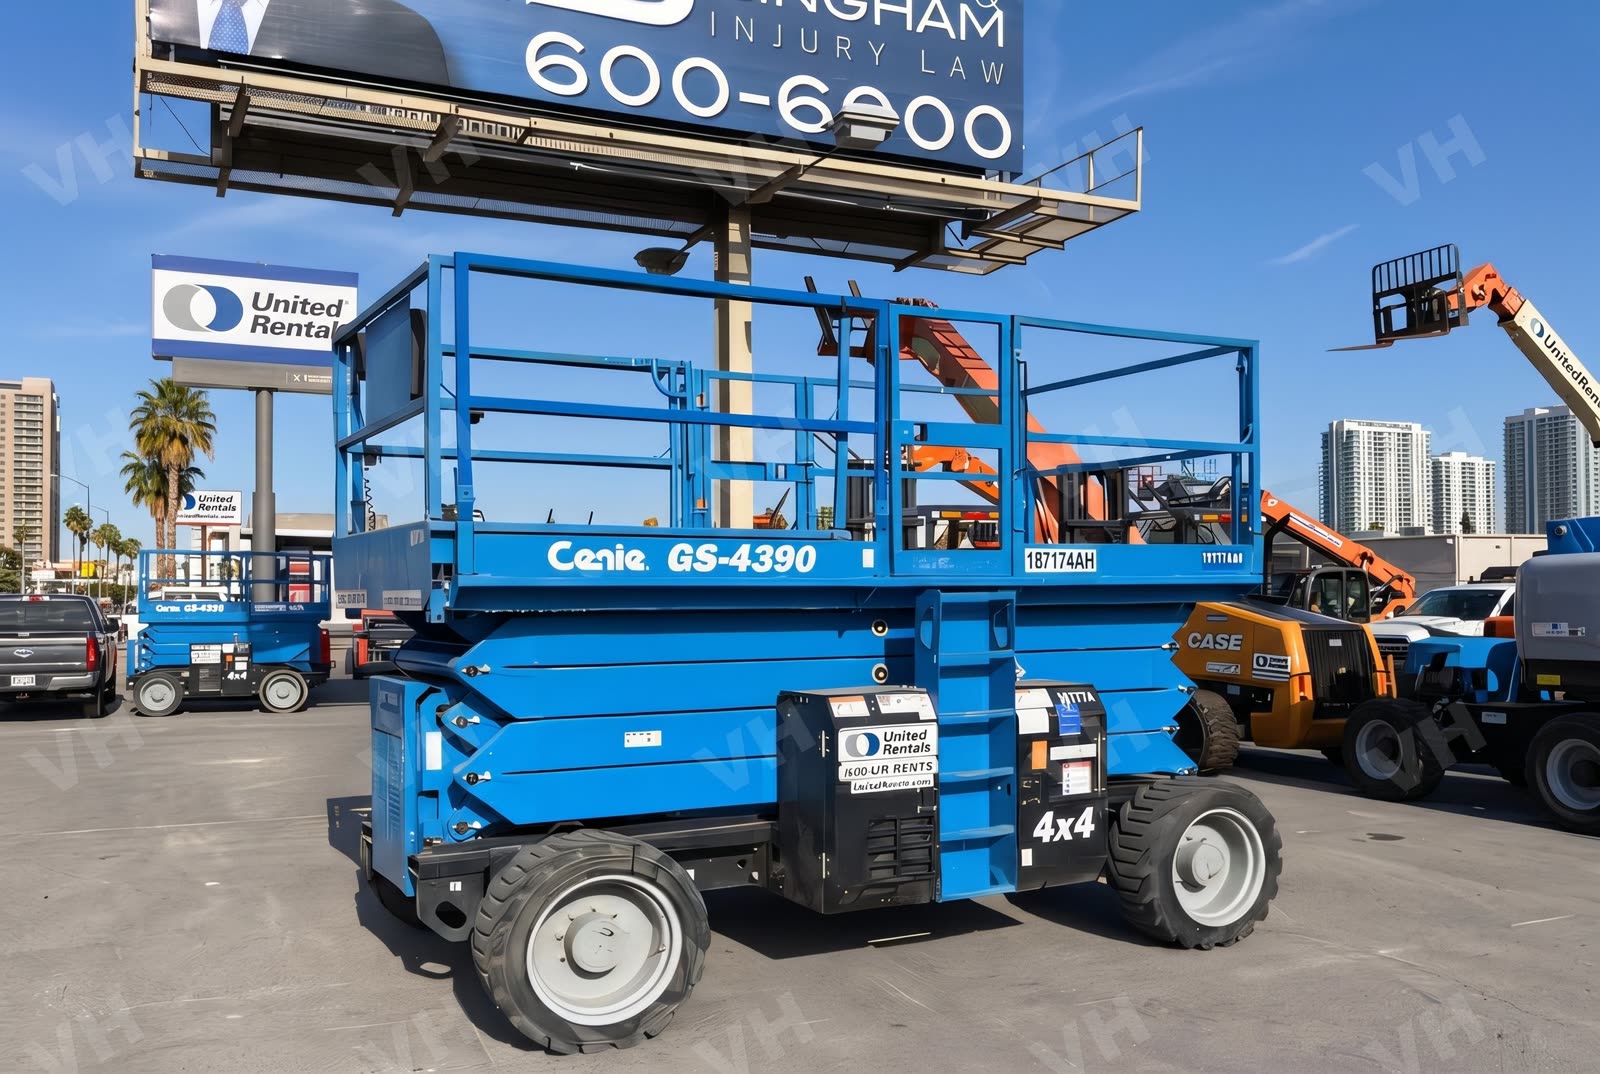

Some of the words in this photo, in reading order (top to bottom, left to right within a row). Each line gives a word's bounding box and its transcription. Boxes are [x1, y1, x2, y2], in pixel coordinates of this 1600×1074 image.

[710, 11, 885, 66] INJURY
[921, 50, 1004, 85] LAW
[251, 291, 344, 318] United
[250, 314, 340, 339] Rental
[198, 494, 233, 503] United
[198, 503, 237, 511] Rentals
[667, 542, 816, 572] GS-4390
[1026, 551, 1095, 570] 187174AH
[1187, 632, 1243, 650] CASE
[227, 671, 247, 681] 4x4
[883, 729, 927, 742] United
[882, 742, 931, 755] Rentals
[893, 761, 933, 774] RENTS
[1033, 806, 1095, 843] 4x4
